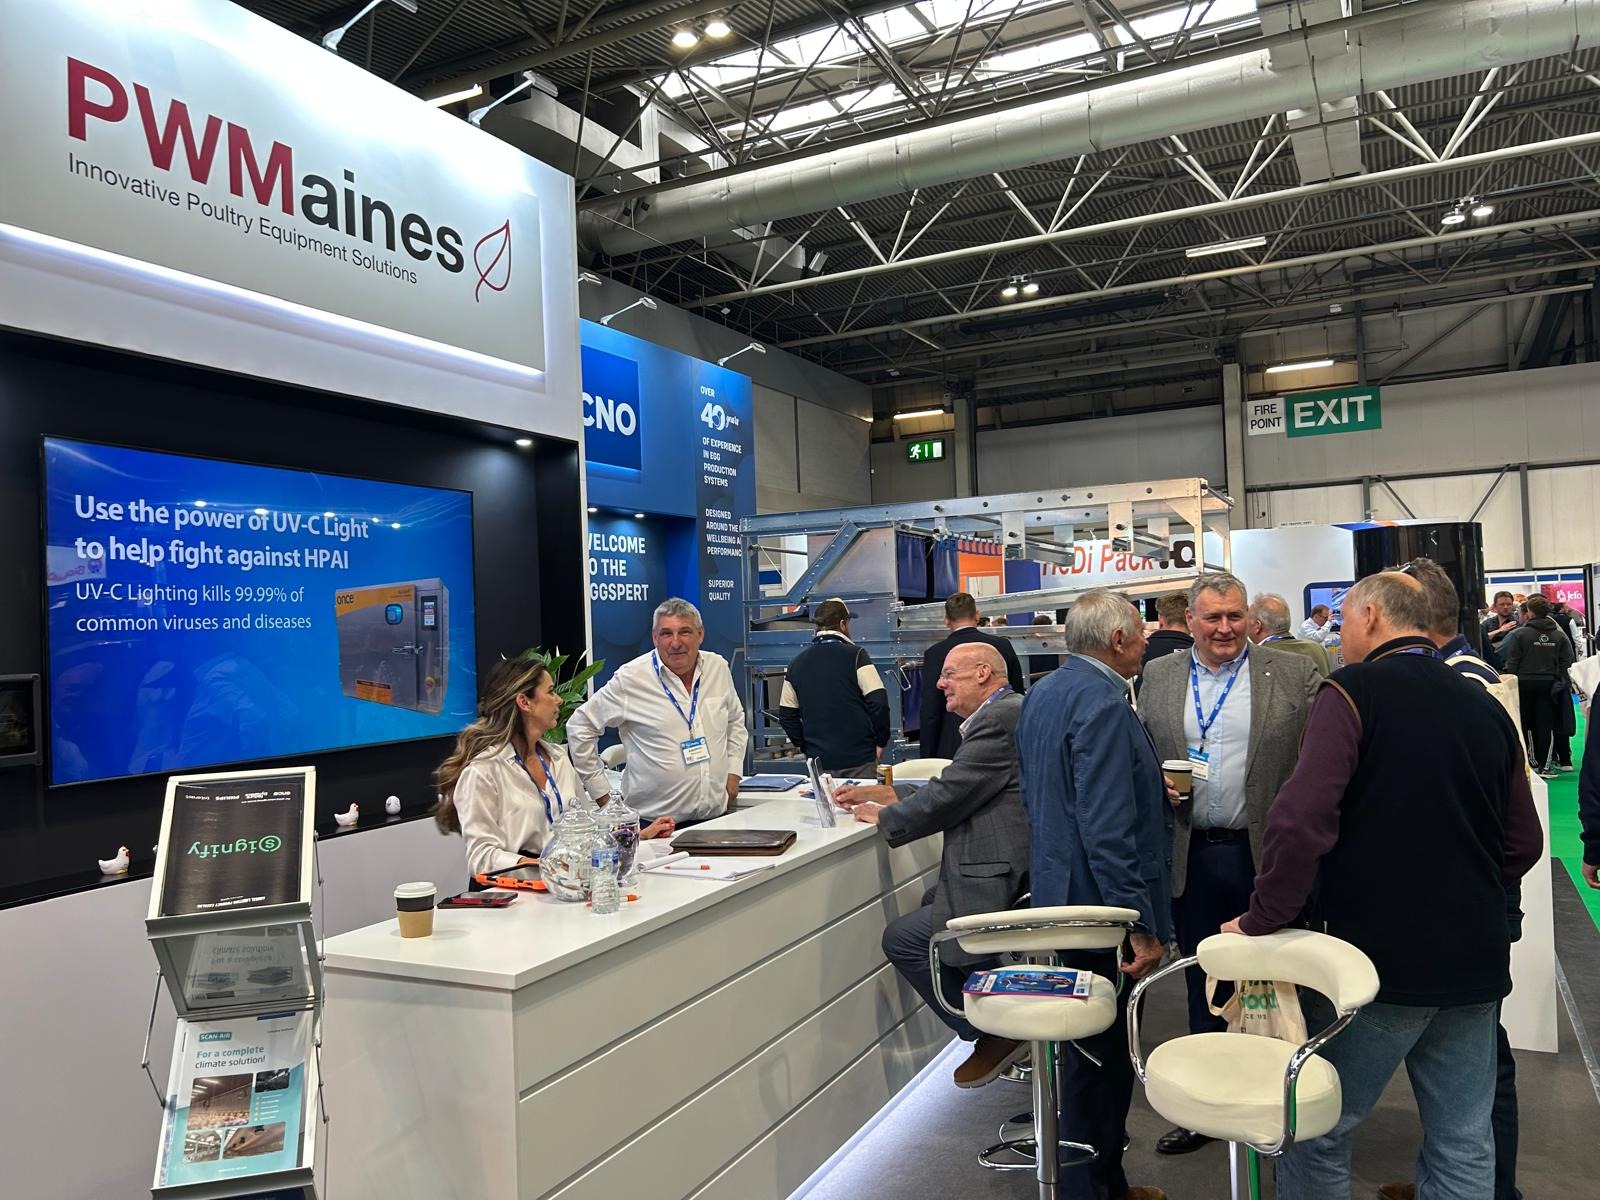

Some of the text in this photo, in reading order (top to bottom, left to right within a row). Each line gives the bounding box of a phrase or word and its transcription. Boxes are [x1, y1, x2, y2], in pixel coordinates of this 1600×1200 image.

[67, 56, 464, 273] PWMaines
[69, 152, 417, 283] Innovative Poultry Equipment Solutions
[700, 385, 716, 398] OVER
[700, 402, 726, 431] 40
[1254, 403, 1278, 416] FIRE
[1293, 395, 1372, 429] EXIT
[1250, 417, 1282, 430] POINT
[702, 436, 742, 454] OF EXPERIENCE
[702, 448, 720, 461] IN EGG
[703, 462, 737, 477] PRODUCTION
[703, 475, 729, 487] SYSTEMS
[75, 494, 369, 542] Use the power of UV-C Light
[705, 508, 732, 520] DESIGNED
[705, 521, 739, 533] AROUND THE
[706, 533, 736, 545] WELLBEING
[75, 535, 349, 571] to help fight against HPAI
[601, 558, 627, 577] THE
[708, 579, 735, 589] SUPERIOR
[76, 582, 305, 606] UV-C Lighting kills 99.99% of
[708, 592, 731, 602] QUALITY
[76, 613, 312, 631] common viruses and diseases
[187, 835, 282, 858] signify
[196, 1049, 212, 1059] For
[222, 1046, 265, 1057] complete
[195, 1055, 266, 1069] climate solution!
